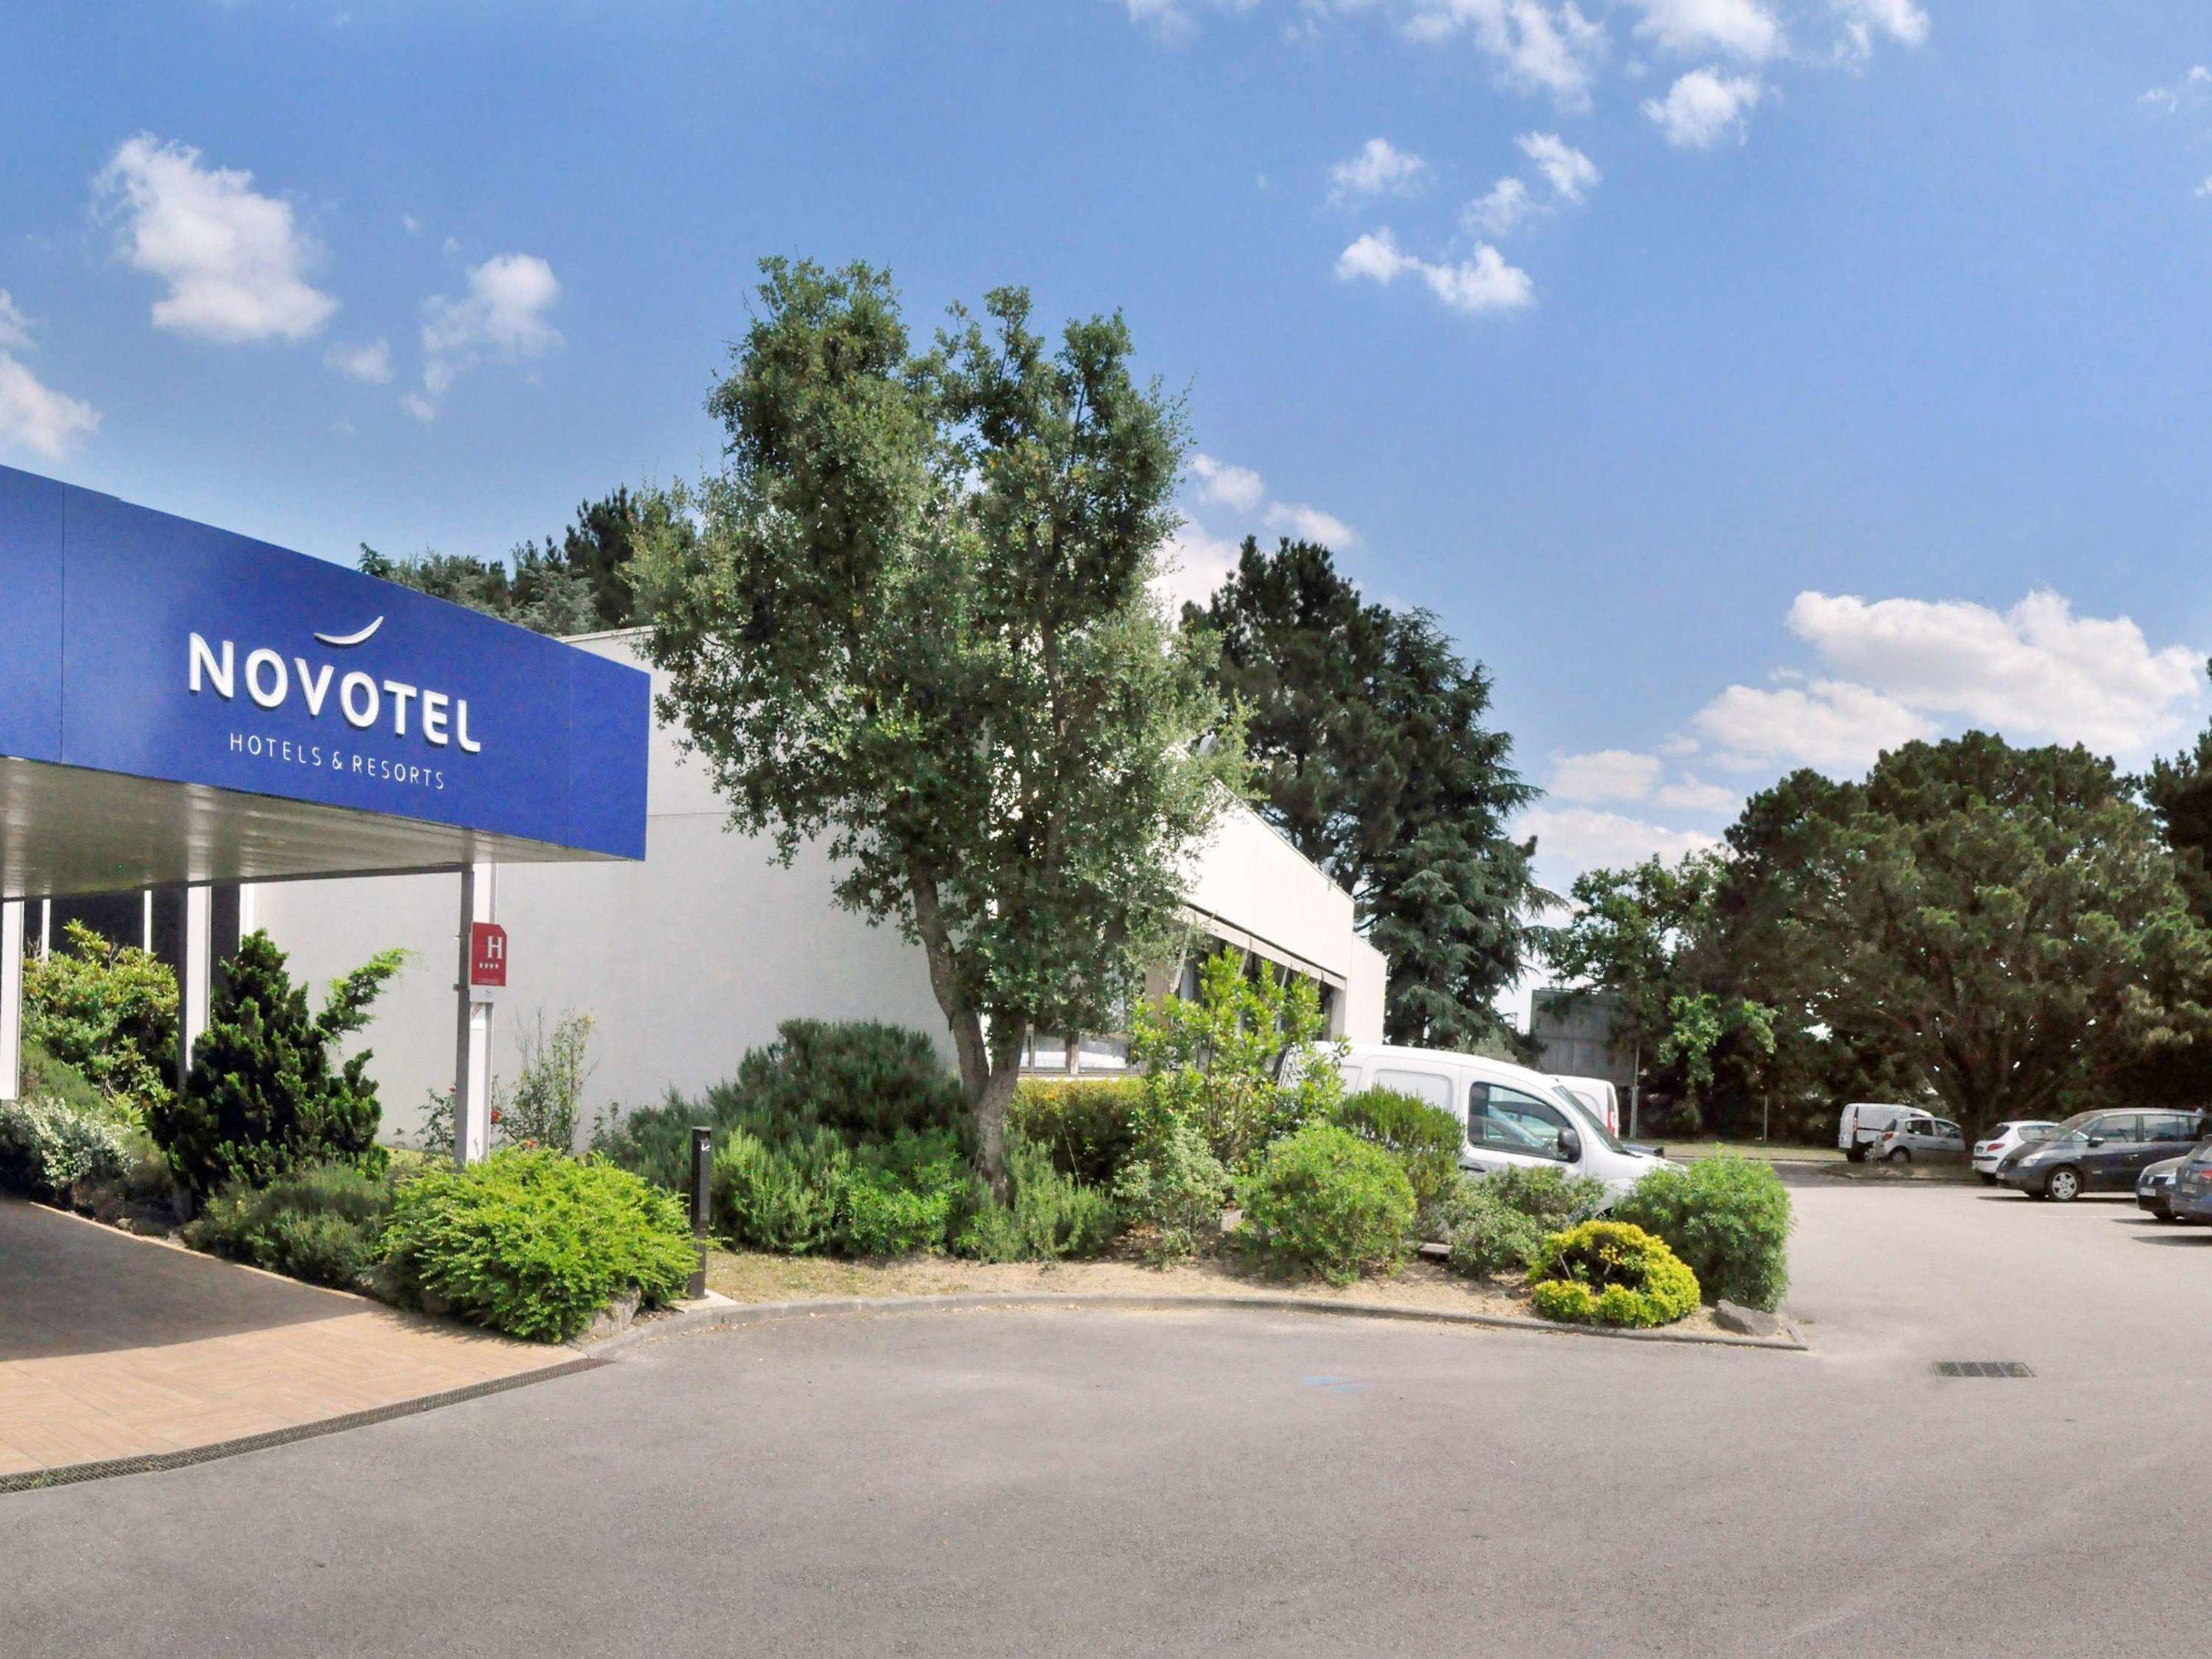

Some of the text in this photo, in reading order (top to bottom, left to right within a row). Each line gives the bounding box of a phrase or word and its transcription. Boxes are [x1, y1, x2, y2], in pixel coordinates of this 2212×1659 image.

[189, 632, 482, 753] NOVOTEL
[230, 733, 444, 790] HOTELS & RESORTS
[487, 935, 503, 959] H
